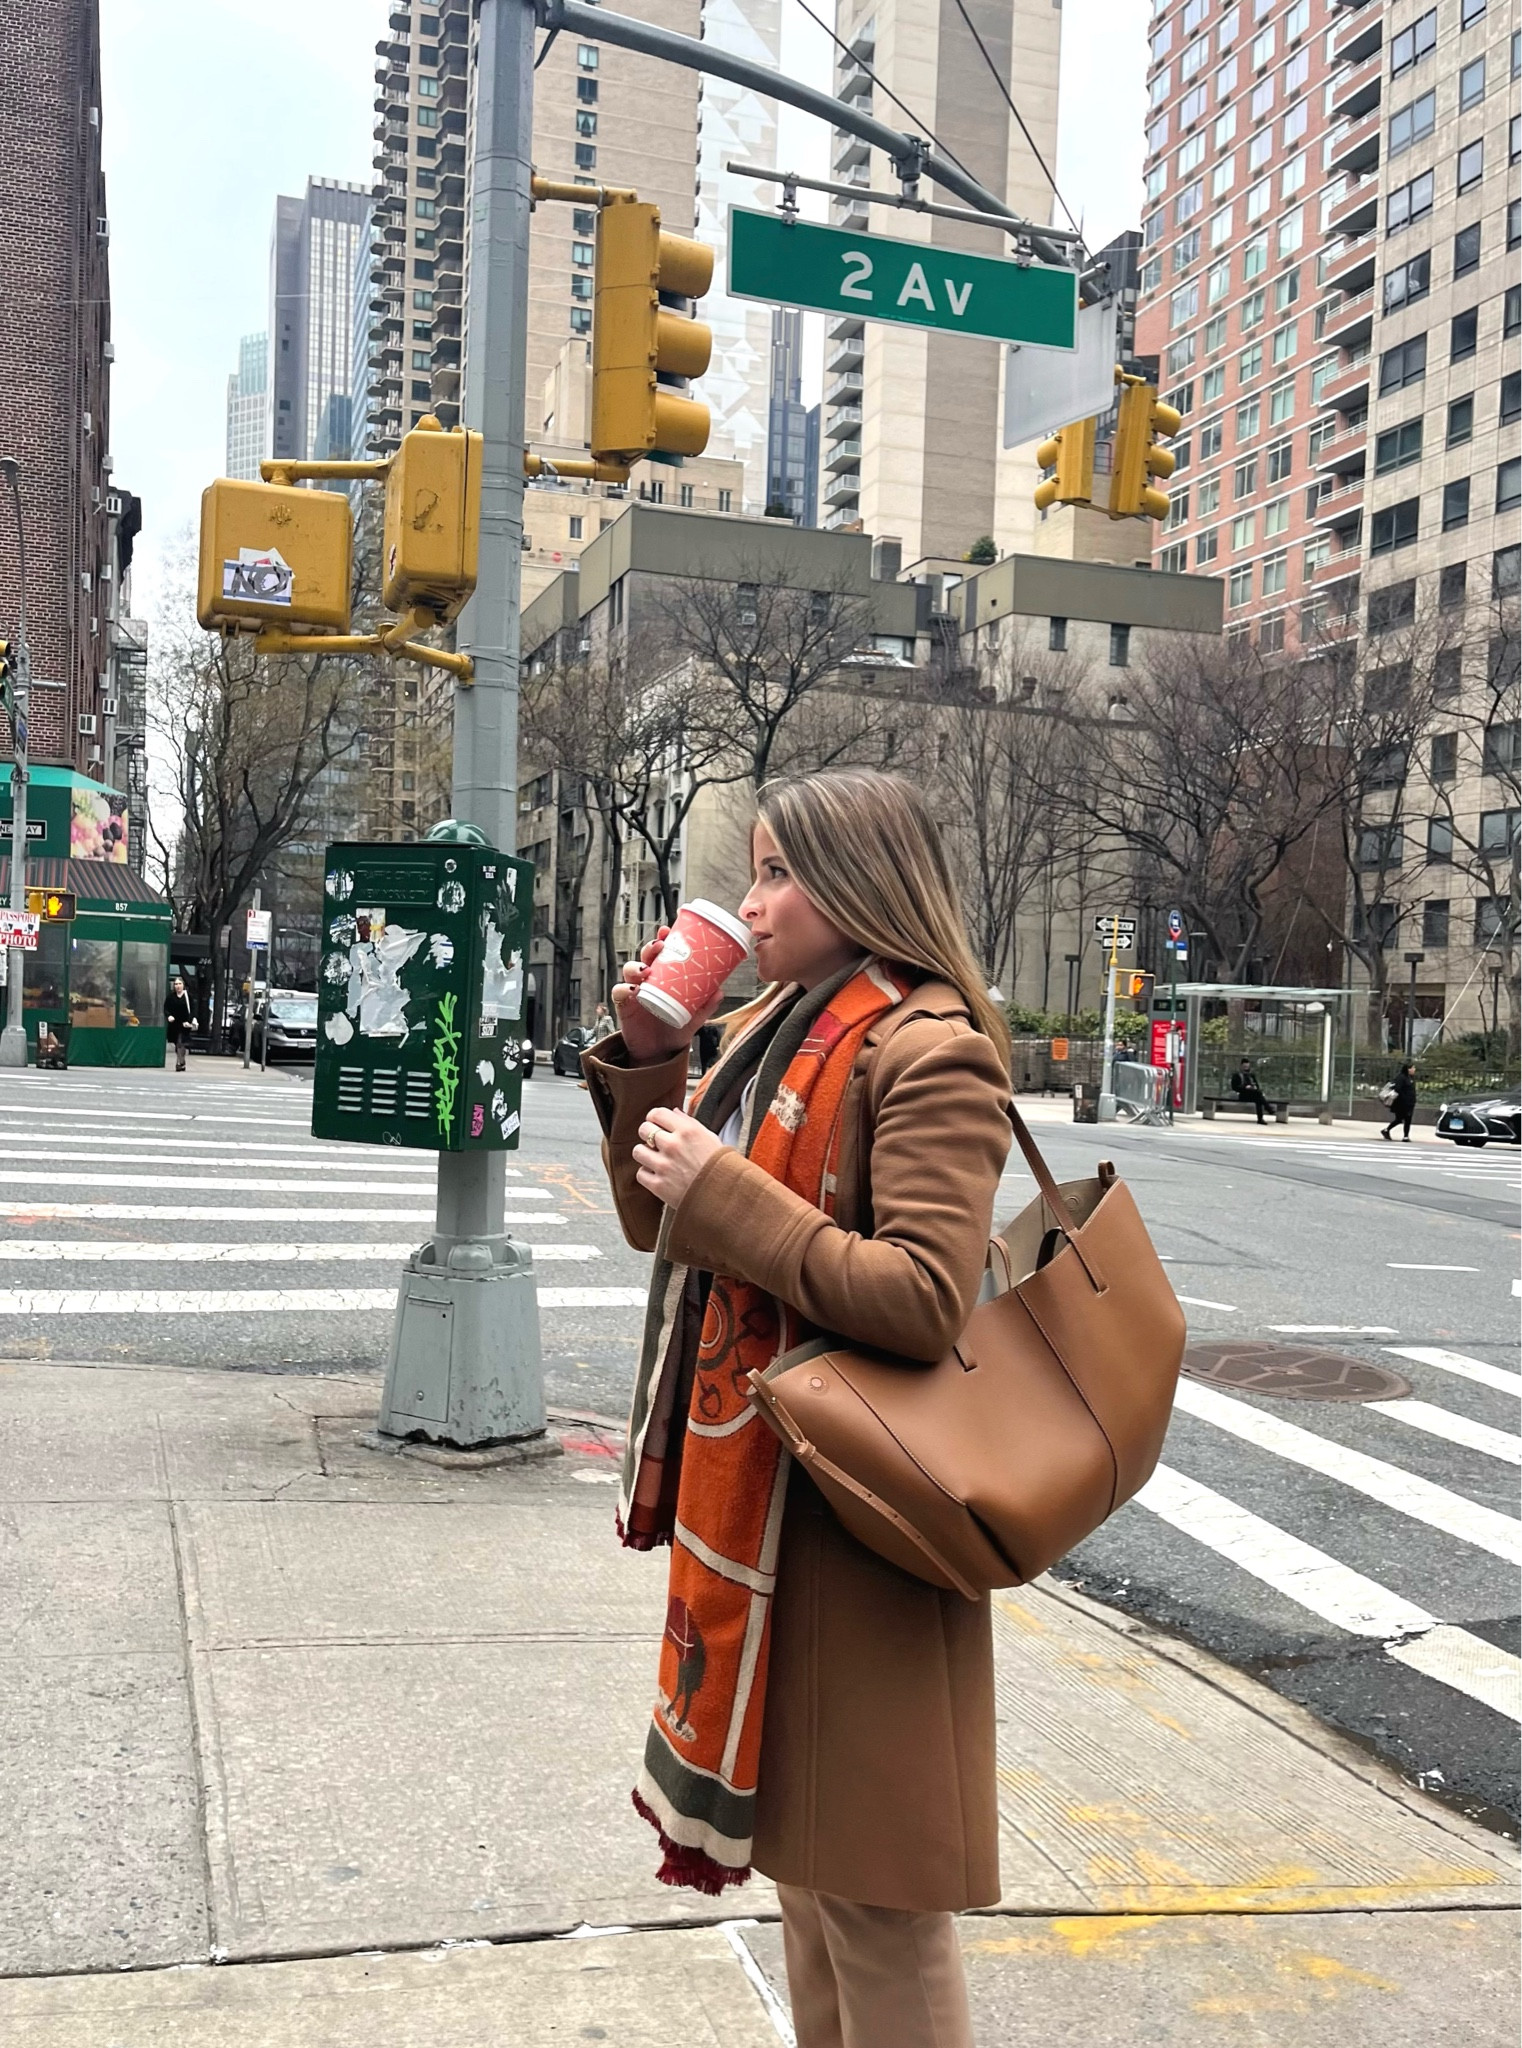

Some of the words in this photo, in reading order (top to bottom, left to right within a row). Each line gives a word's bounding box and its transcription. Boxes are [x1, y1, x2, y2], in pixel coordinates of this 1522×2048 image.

[839, 251, 874, 301] 2
[896, 262, 974, 316] Av
[115, 902, 128, 912] 857
[0, 911, 37, 924] PASSPORT
[0, 933, 37, 947] PHOTO
